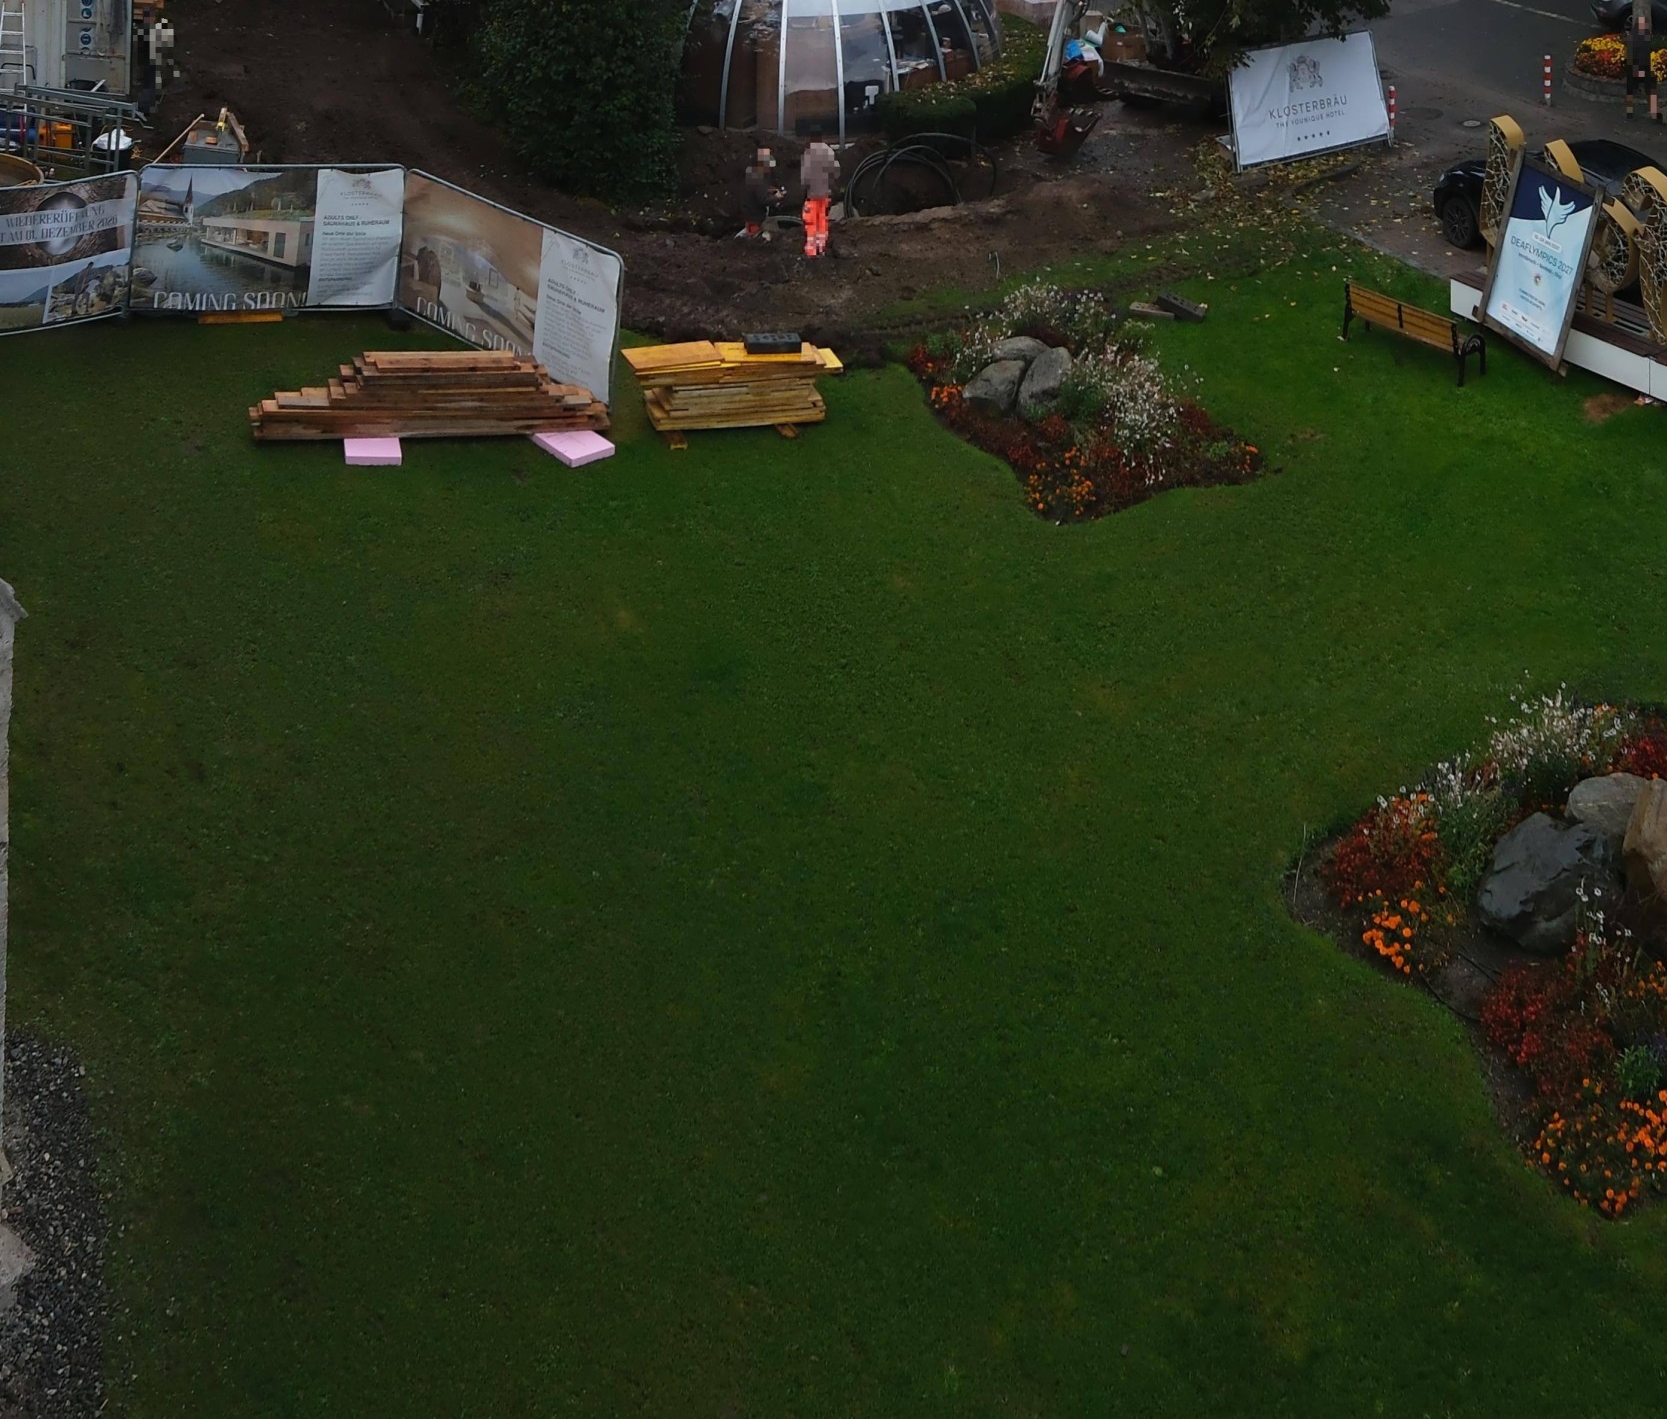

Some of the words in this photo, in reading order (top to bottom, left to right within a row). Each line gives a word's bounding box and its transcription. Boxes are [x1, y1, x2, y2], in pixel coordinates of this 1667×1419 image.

[1269, 94, 1348, 120] KLOSTERBRÄU
[1276, 120, 1289, 129] THE
[1291, 113, 1324, 126] YOUNIQUE
[1325, 109, 1346, 119] HOTEL
[1511, 236, 1558, 268] DEAFLYMPICS
[1557, 259, 1574, 276] 2027
[153, 291, 237, 310] COMING
[416, 296, 477, 343] COMING
